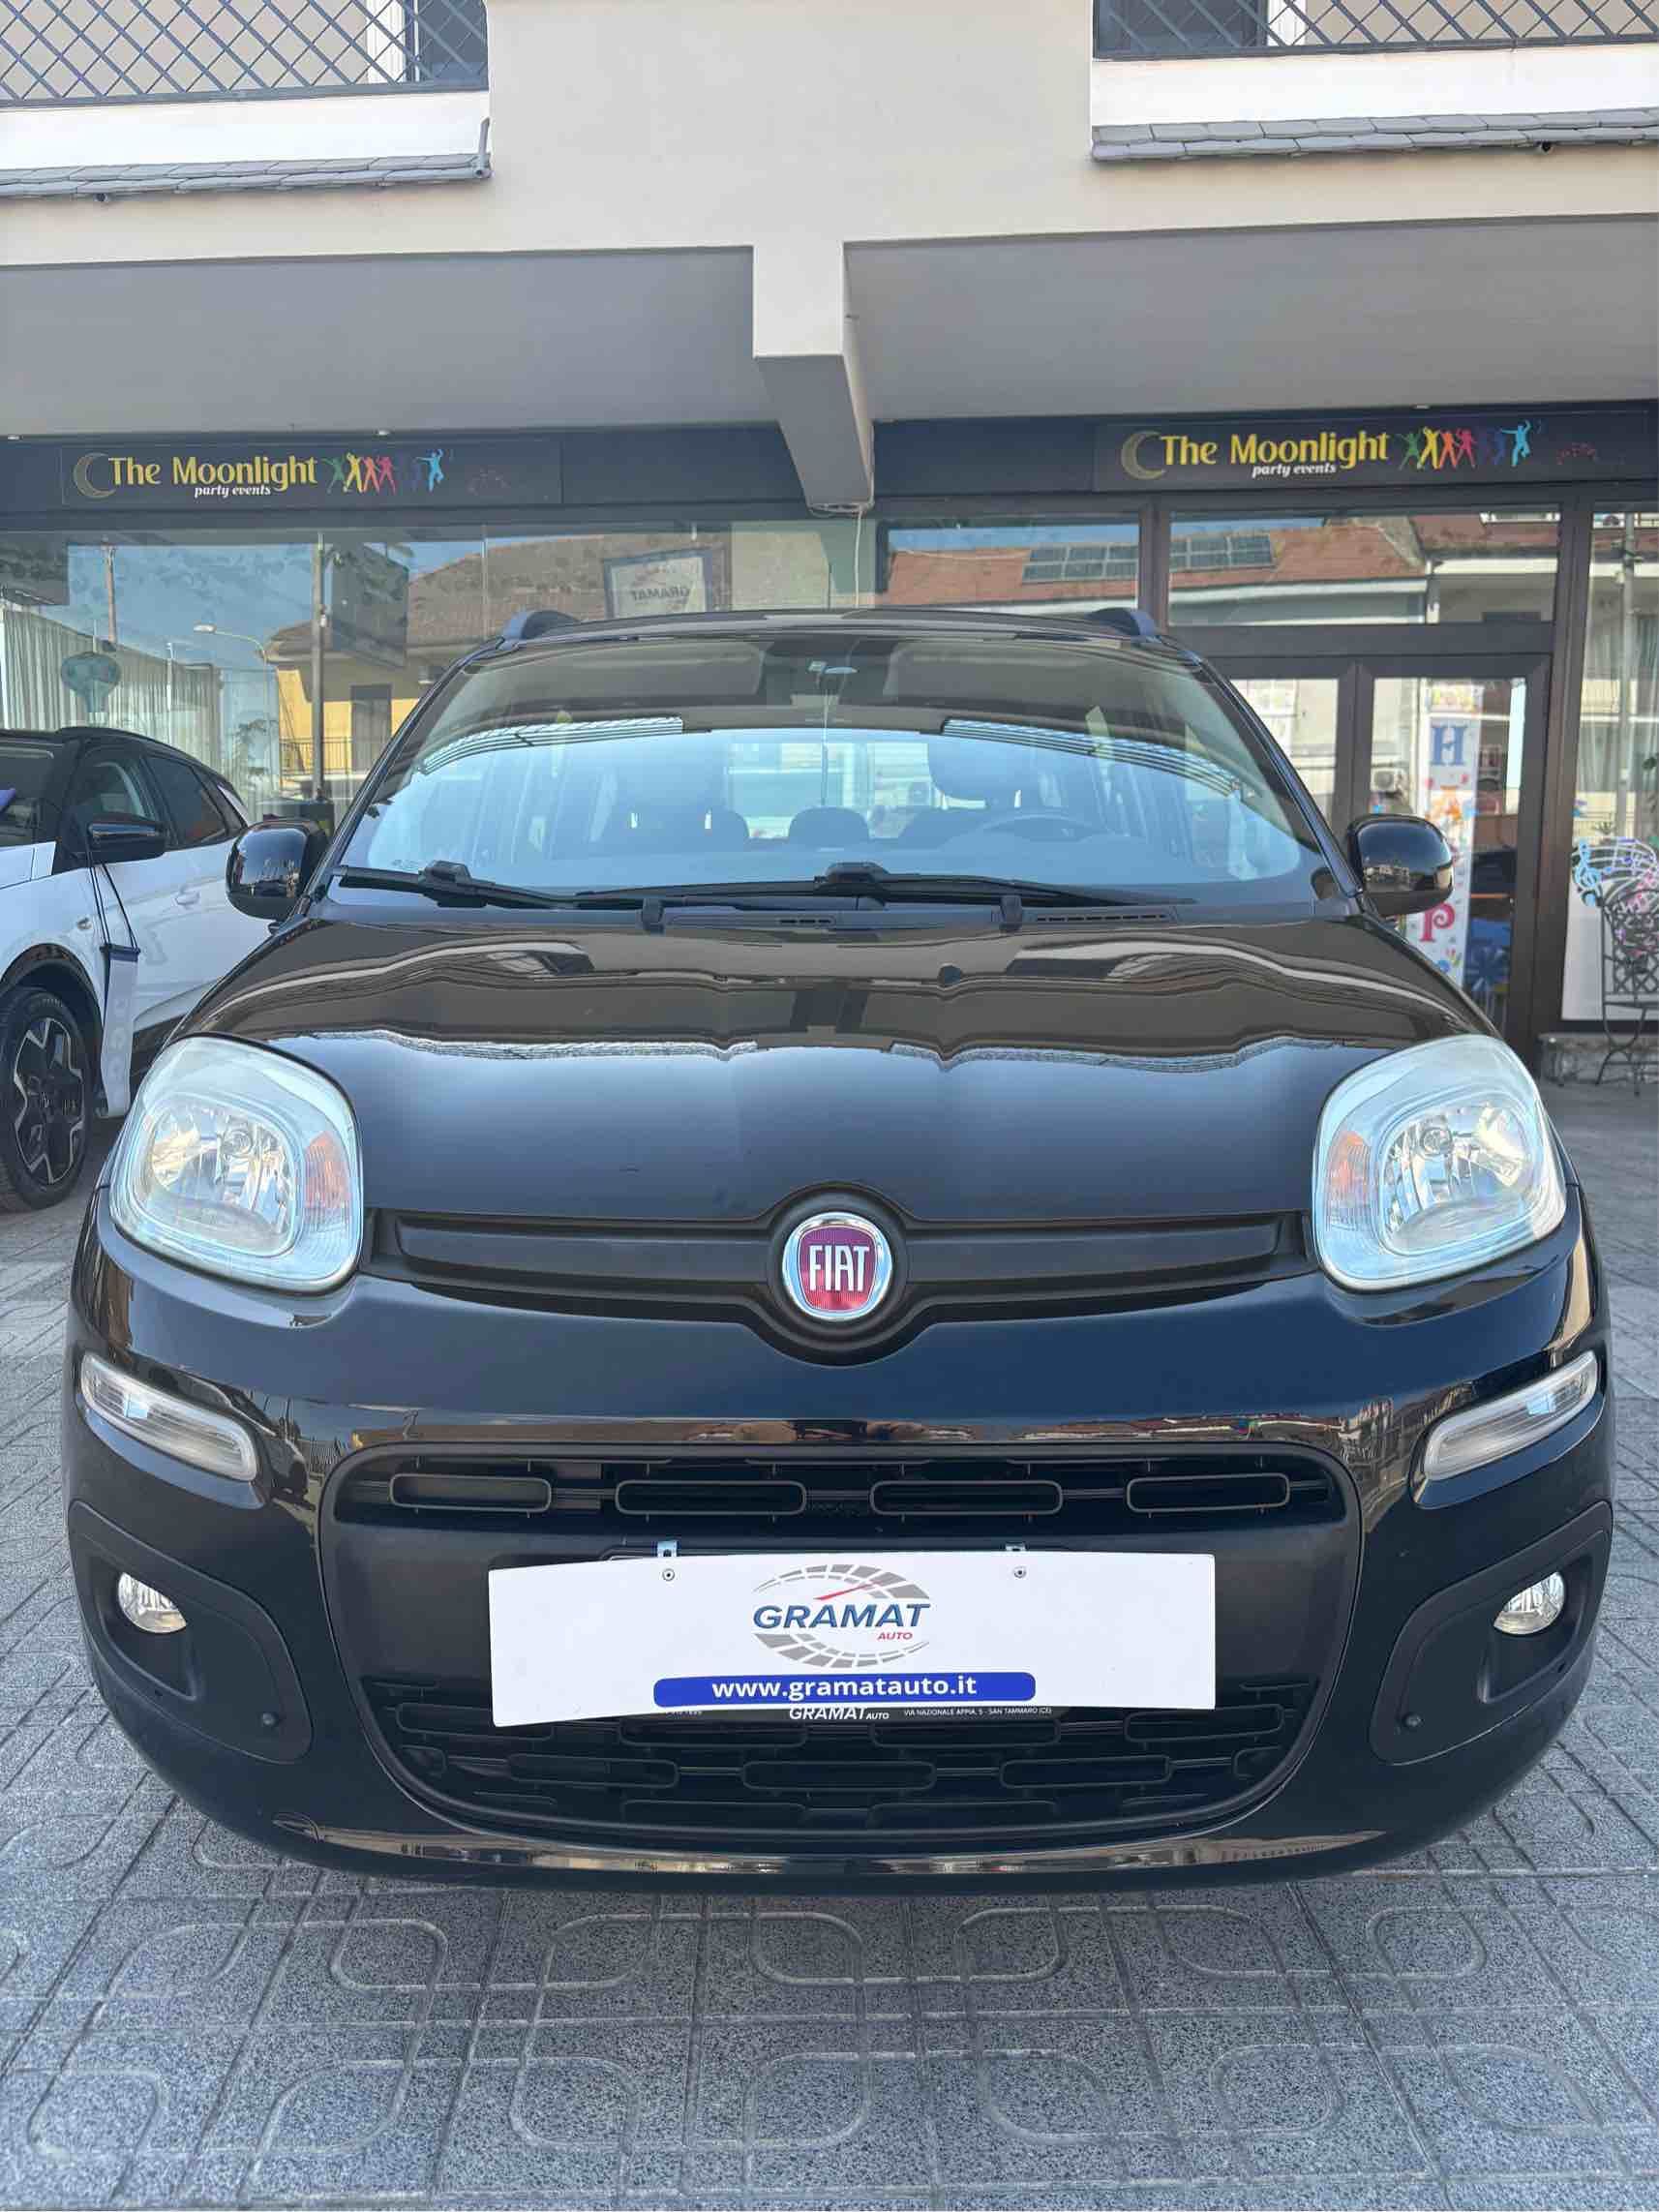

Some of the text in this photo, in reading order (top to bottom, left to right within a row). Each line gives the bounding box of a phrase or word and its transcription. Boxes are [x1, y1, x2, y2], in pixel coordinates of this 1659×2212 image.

[1160, 431, 1389, 469] The Moonlight
[108, 455, 317, 491] The Moonlight
[1252, 463, 1337, 478] party events
[194, 484, 272, 499] party events
[809, 1245, 870, 1292] FIAT
[753, 1603, 930, 1629] GRAMAT
[877, 1631, 913, 1641] AUTO
[711, 1676, 977, 1701] www.gramatauto.it
[789, 1707, 890, 1720] GRAMAT AUTO
